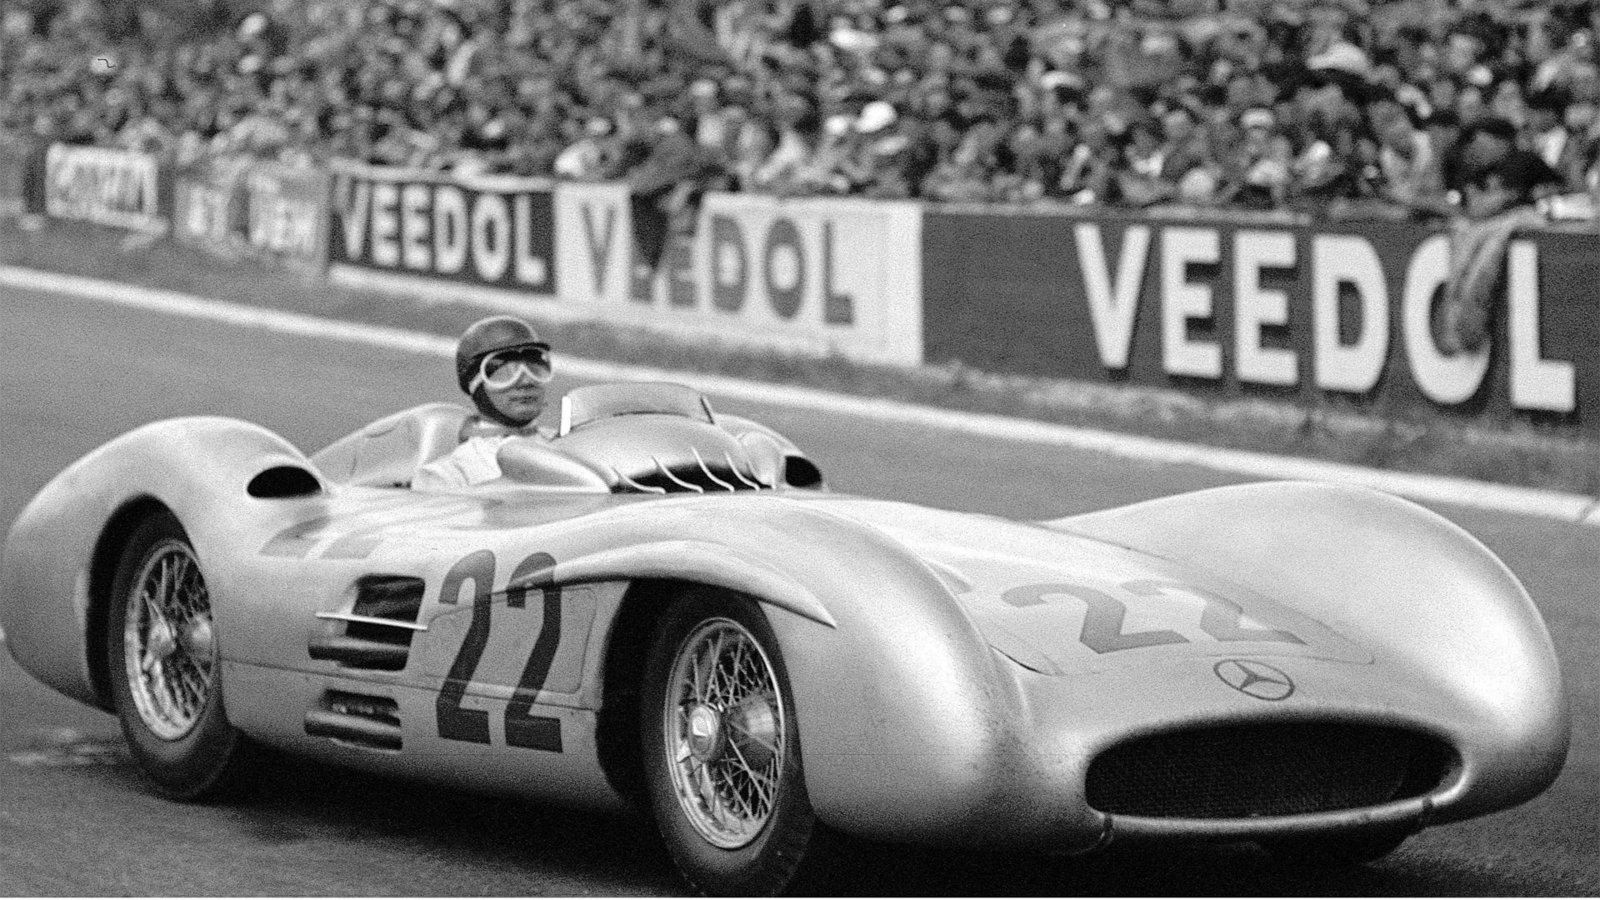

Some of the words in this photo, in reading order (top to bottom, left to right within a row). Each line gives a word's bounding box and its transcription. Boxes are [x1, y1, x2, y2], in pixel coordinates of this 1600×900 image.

[335, 176, 547, 285] VEEDOL
[1074, 222, 1576, 413] VEEDOL
[435, 549, 563, 754] 22
